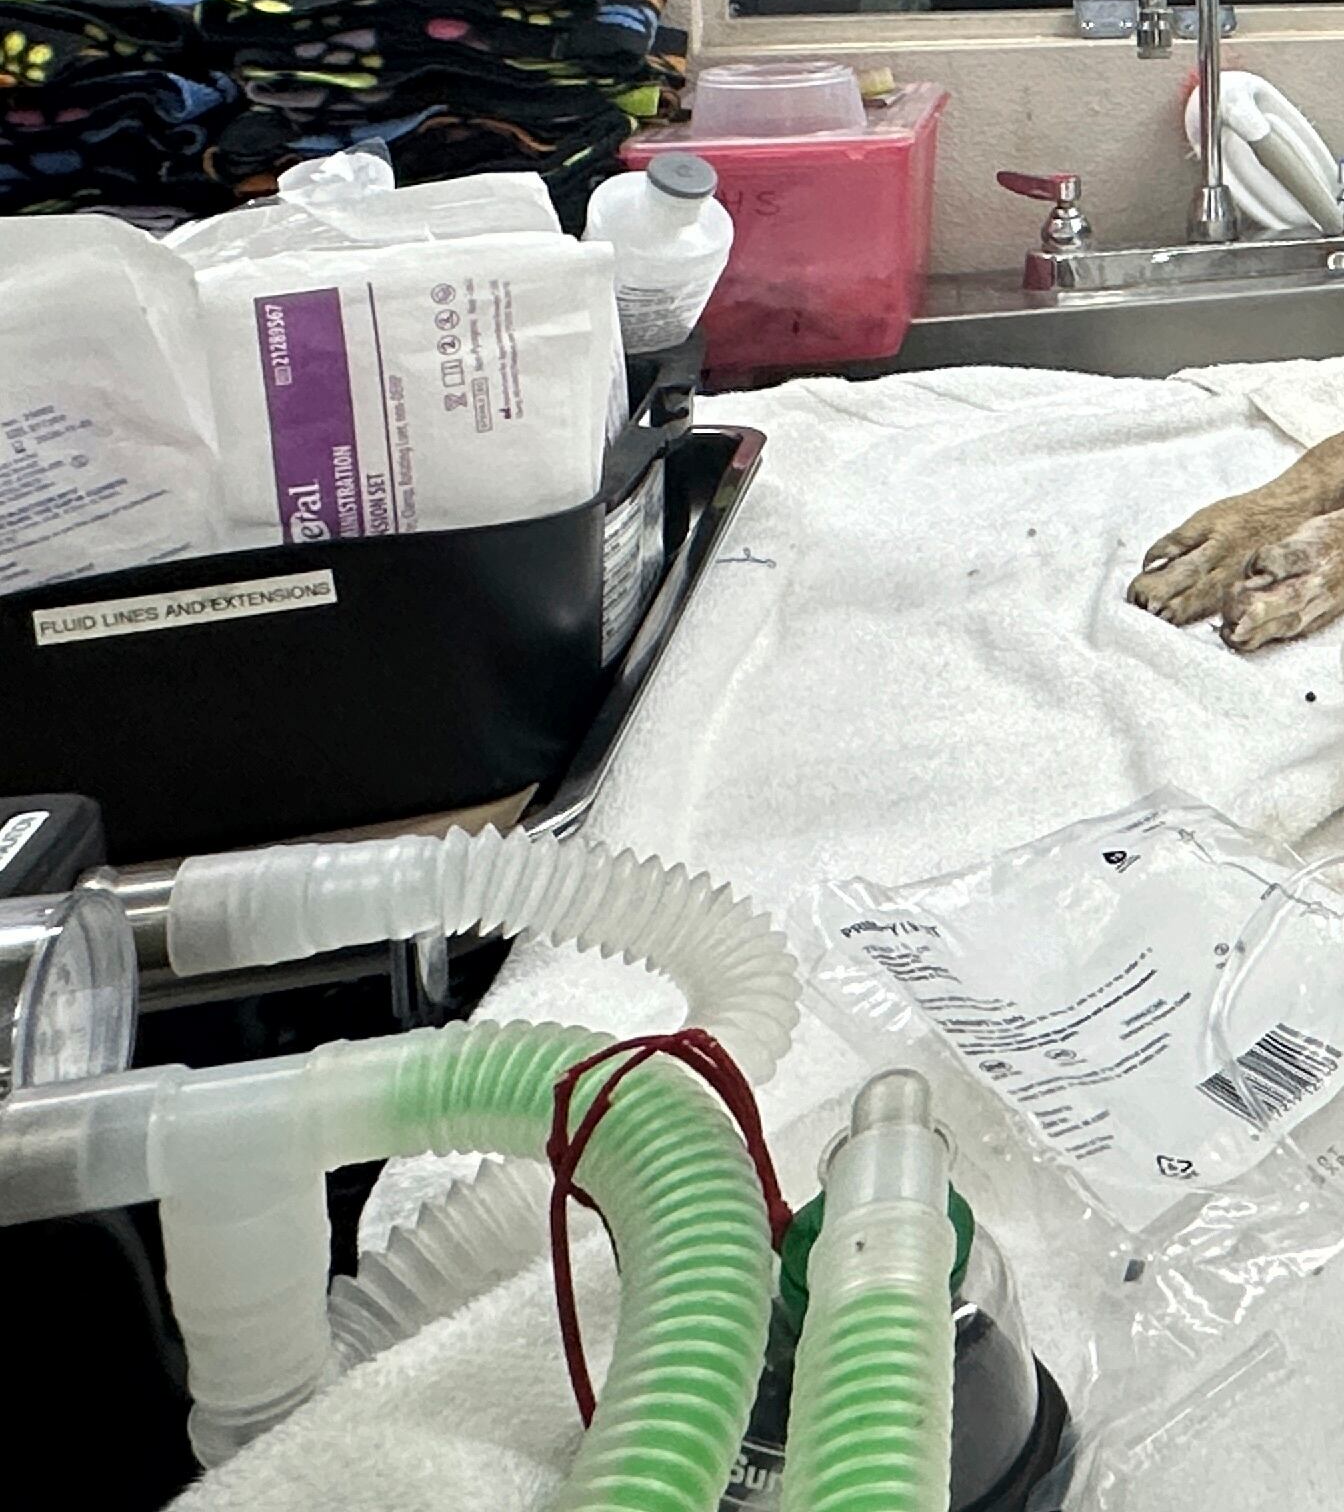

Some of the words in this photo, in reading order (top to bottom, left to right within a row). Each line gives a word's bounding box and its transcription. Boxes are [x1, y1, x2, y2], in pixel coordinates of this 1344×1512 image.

[366, 473, 386, 496] SET
[39, 614, 97, 638] FLUID
[102, 606, 159, 628] LINES
[164, 599, 206, 619] AND
[210, 581, 331, 612] EXTENSIONS
